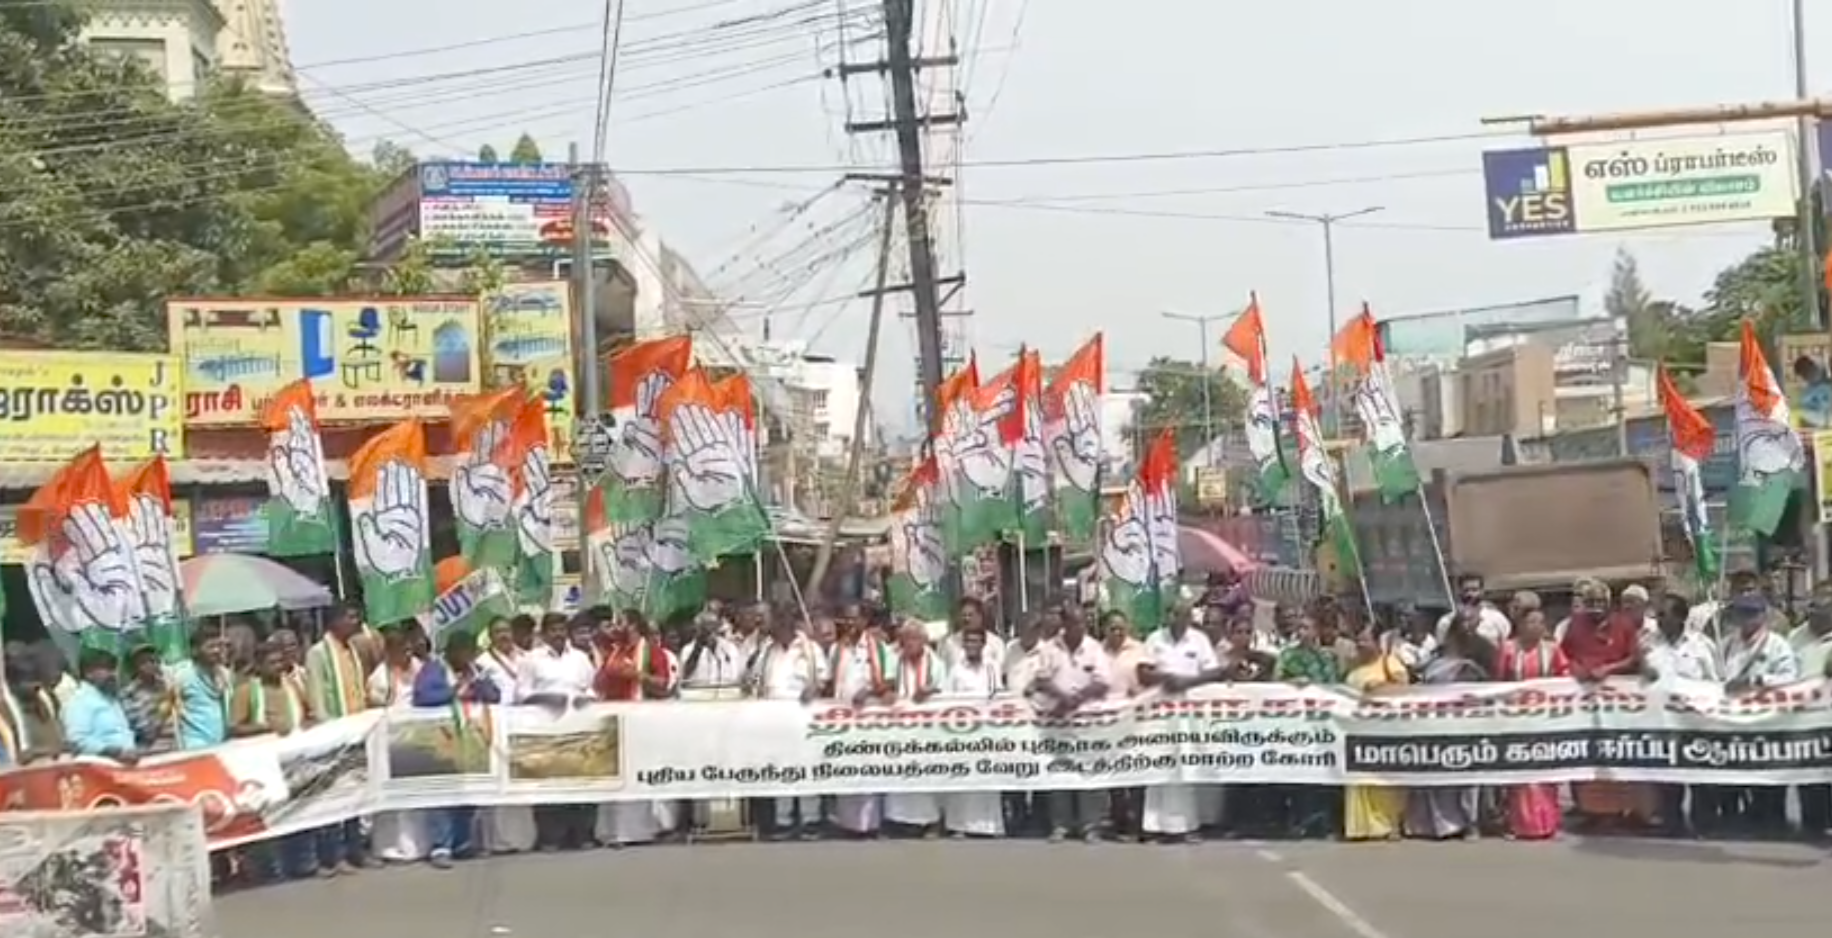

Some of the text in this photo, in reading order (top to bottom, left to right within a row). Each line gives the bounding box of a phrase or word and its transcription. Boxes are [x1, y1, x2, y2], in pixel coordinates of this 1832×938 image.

[1584, 151, 1649, 178] எஸ்
[1495, 193, 1568, 223] YES
[186, 384, 242, 418] ராசி
[823, 737, 1017, 757] திண்டுக்கல்லில்
[1117, 727, 1337, 750] அமையவிருக்கும்
[1354, 737, 1499, 769] மாபெரும்
[1505, 739, 1590, 764] கவன
[637, 766, 696, 786] புதிய
[811, 759, 971, 780] நிலையத்தை
[975, 758, 1040, 778] வேறு
